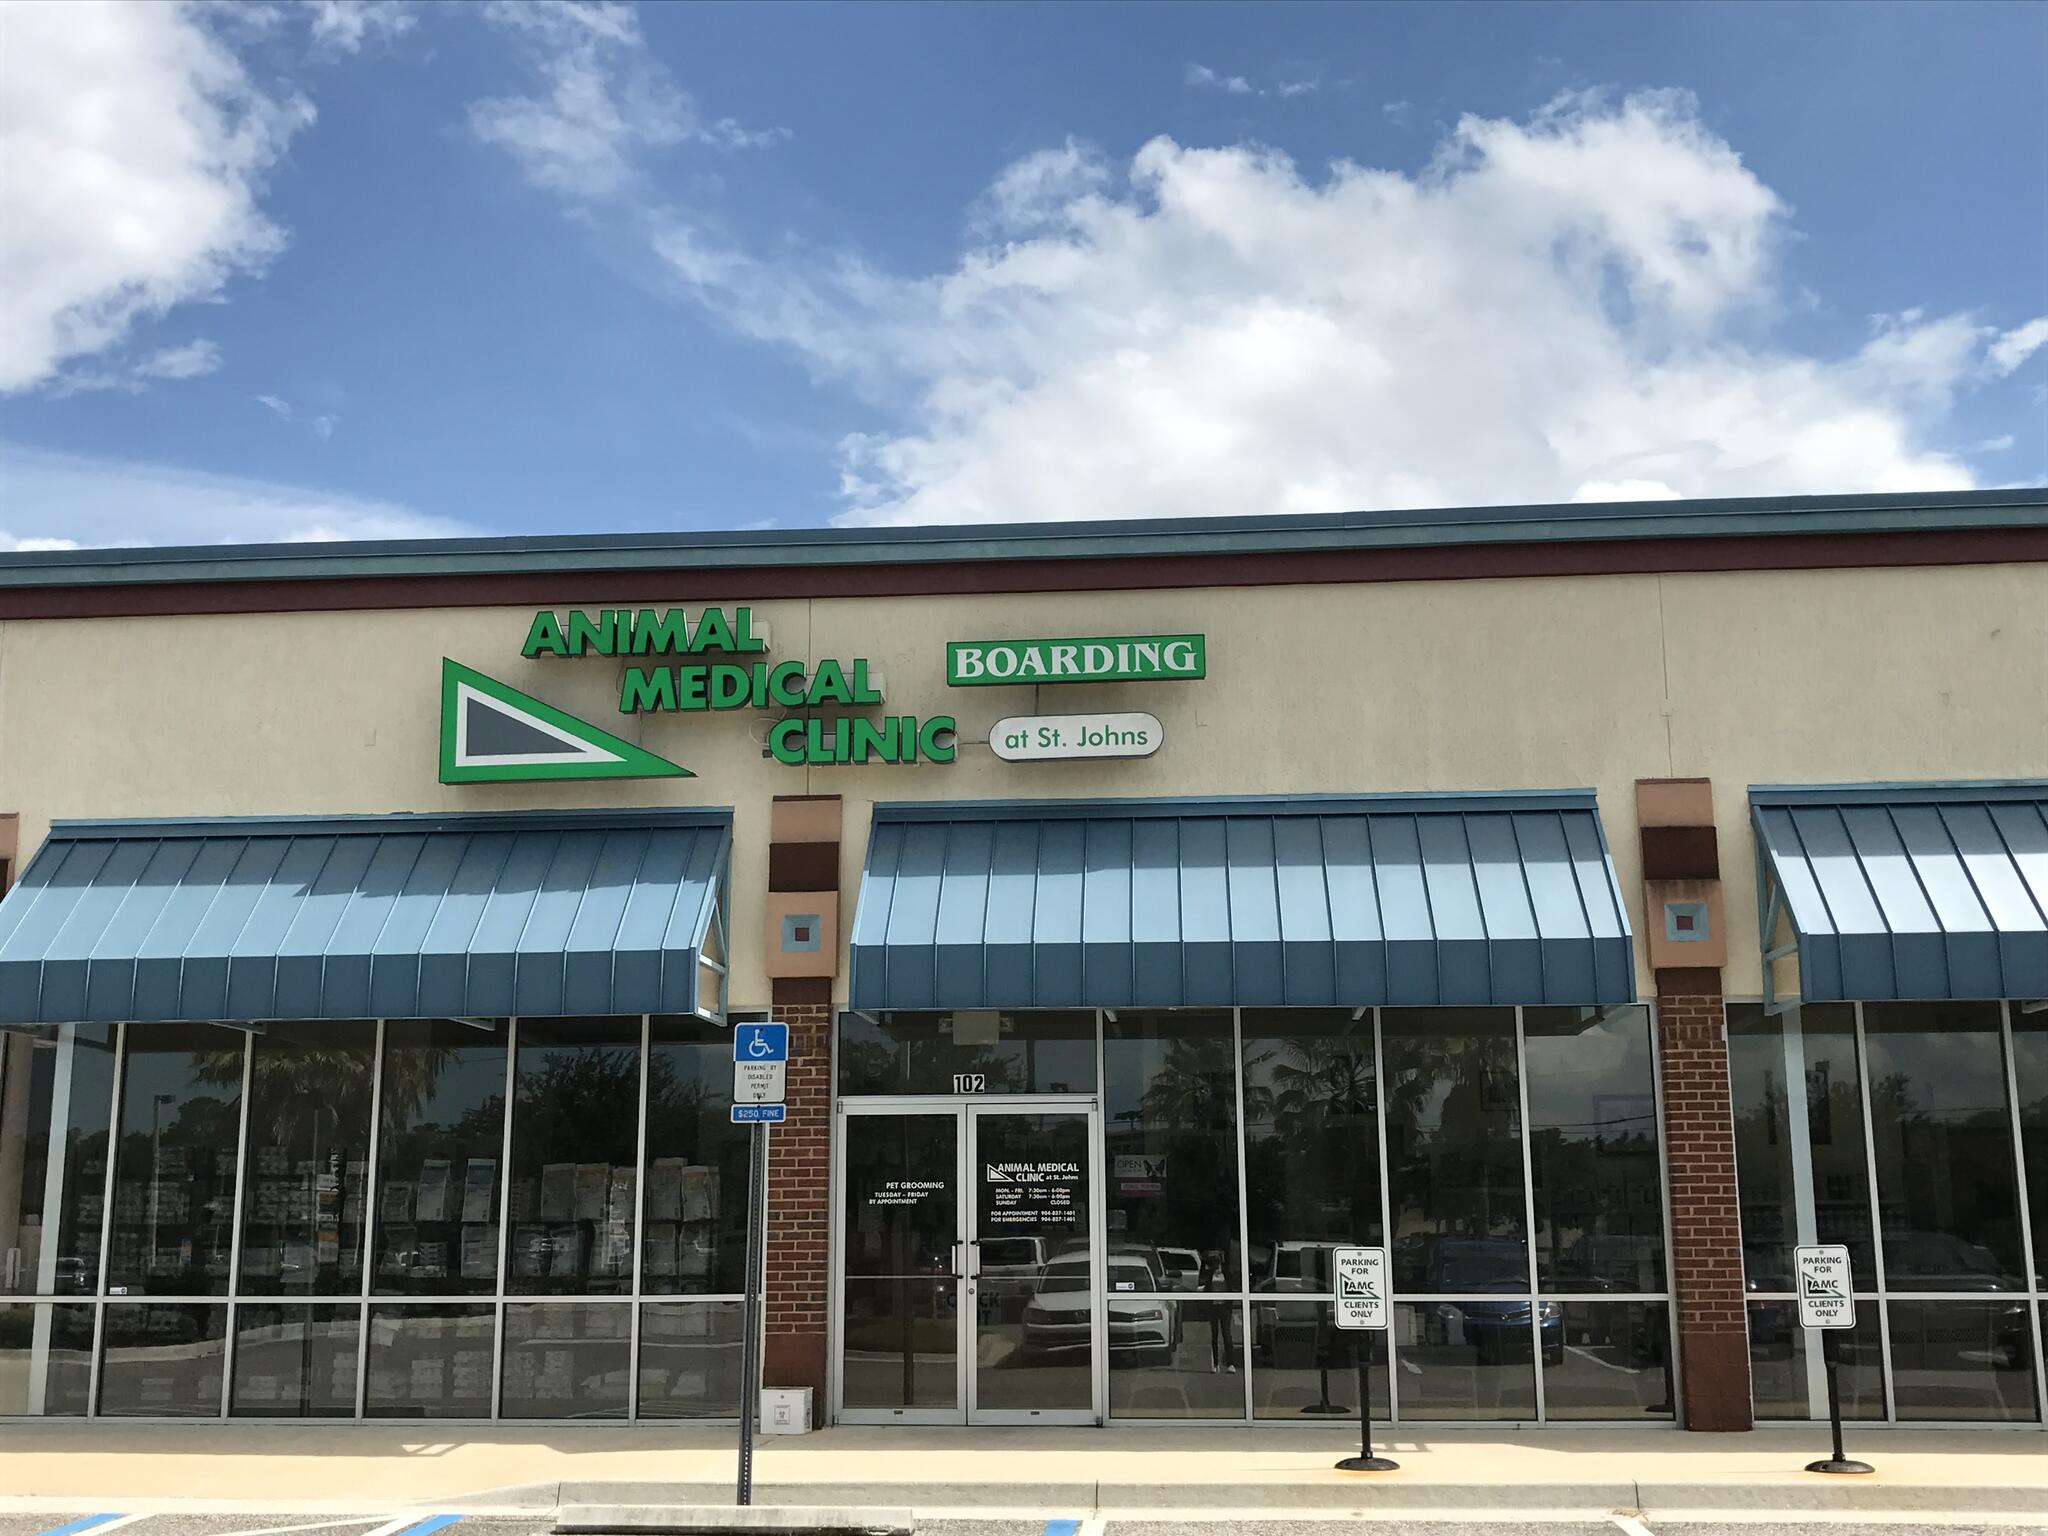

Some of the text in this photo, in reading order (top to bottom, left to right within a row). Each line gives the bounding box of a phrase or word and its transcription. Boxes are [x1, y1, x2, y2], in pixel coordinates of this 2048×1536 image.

[521, 607, 765, 657] ANIMAL
[955, 641, 1197, 678] BOARDING
[619, 658, 882, 713] MEDICAL
[769, 716, 956, 765] CLINIC
[1005, 725, 1149, 749] at St. Johns
[954, 1075, 984, 1093] 102
[738, 1109, 780, 1118] $250 FINE
[998, 1163, 1080, 1172] ANIMAL MEDICAL
[1116, 1160, 1142, 1168] OPEN
[1016, 1173, 1045, 1182] CLINIC
[1349, 1281, 1374, 1290] AMC
[1812, 1280, 1838, 1288] AMC
[1350, 1310, 1373, 1318] ONLY
